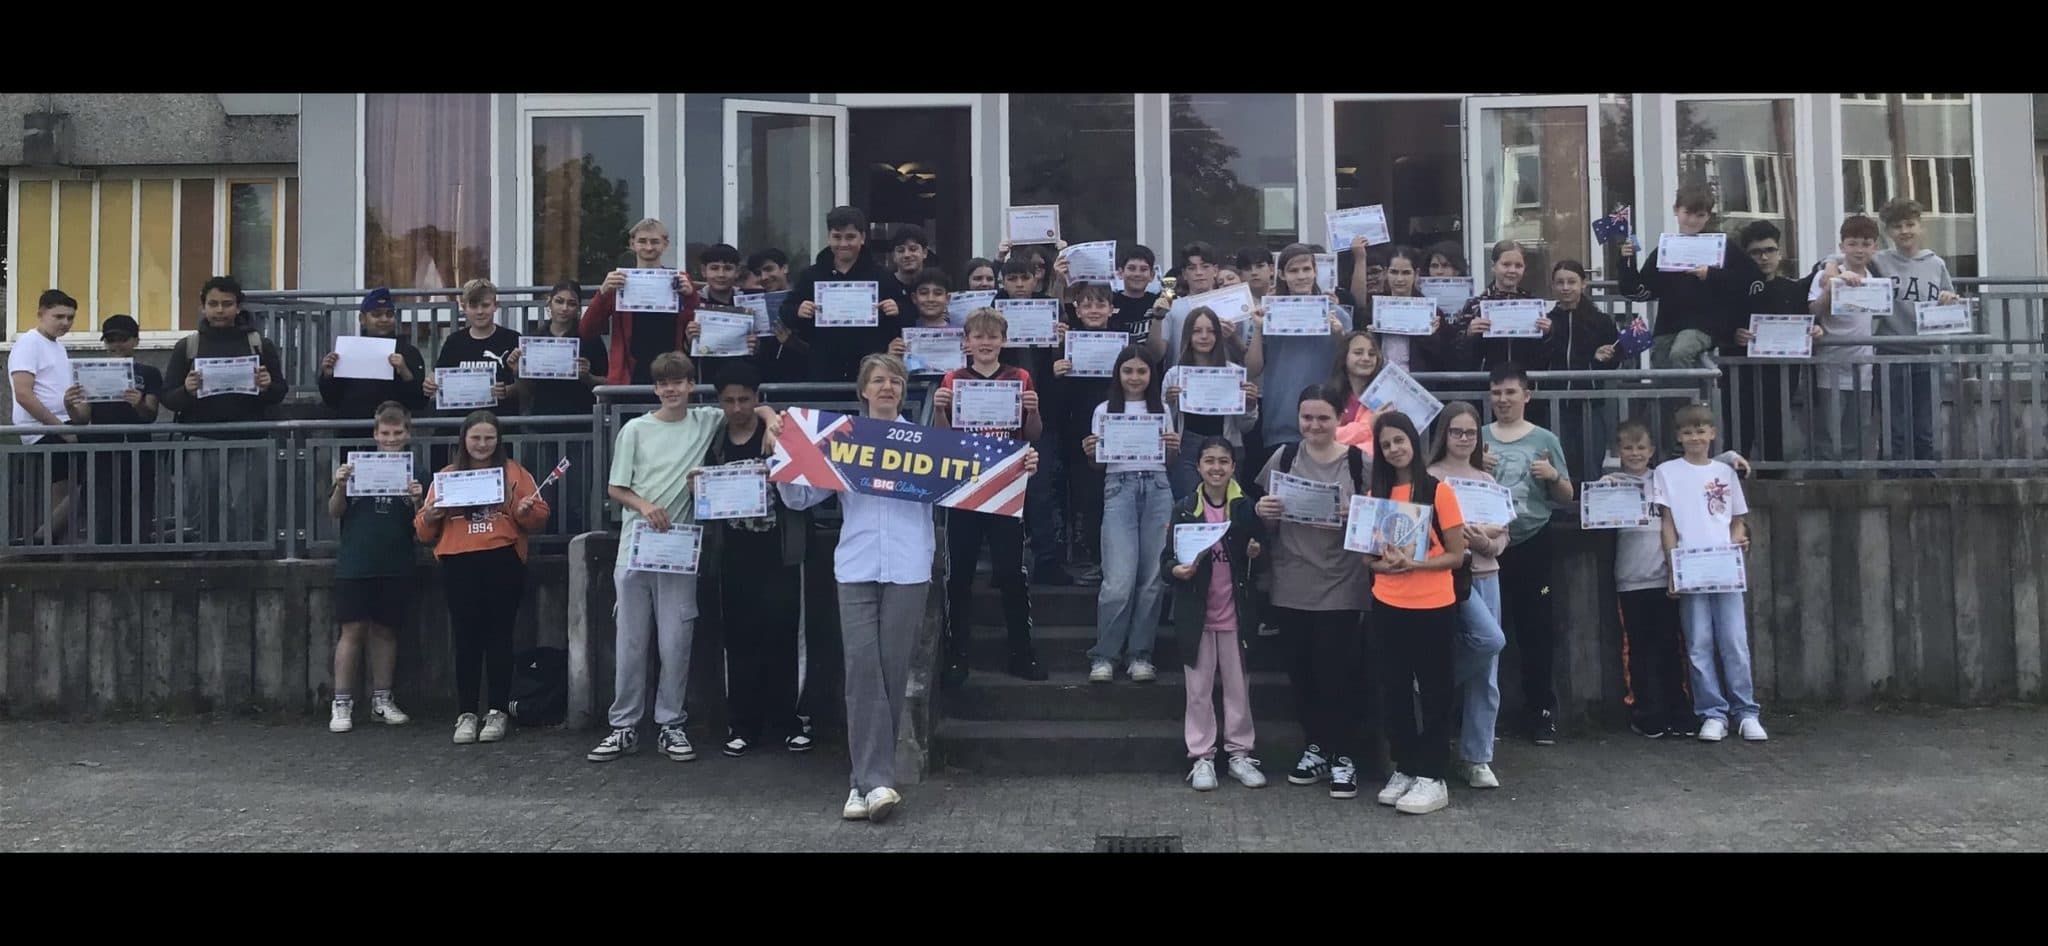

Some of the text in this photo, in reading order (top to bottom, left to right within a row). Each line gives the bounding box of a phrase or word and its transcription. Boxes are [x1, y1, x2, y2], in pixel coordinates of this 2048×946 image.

[886, 427, 923, 444] 2025
[830, 440, 981, 483] WE DID IT!
[873, 478, 896, 492] BIG
[467, 522, 494, 535] 1994
